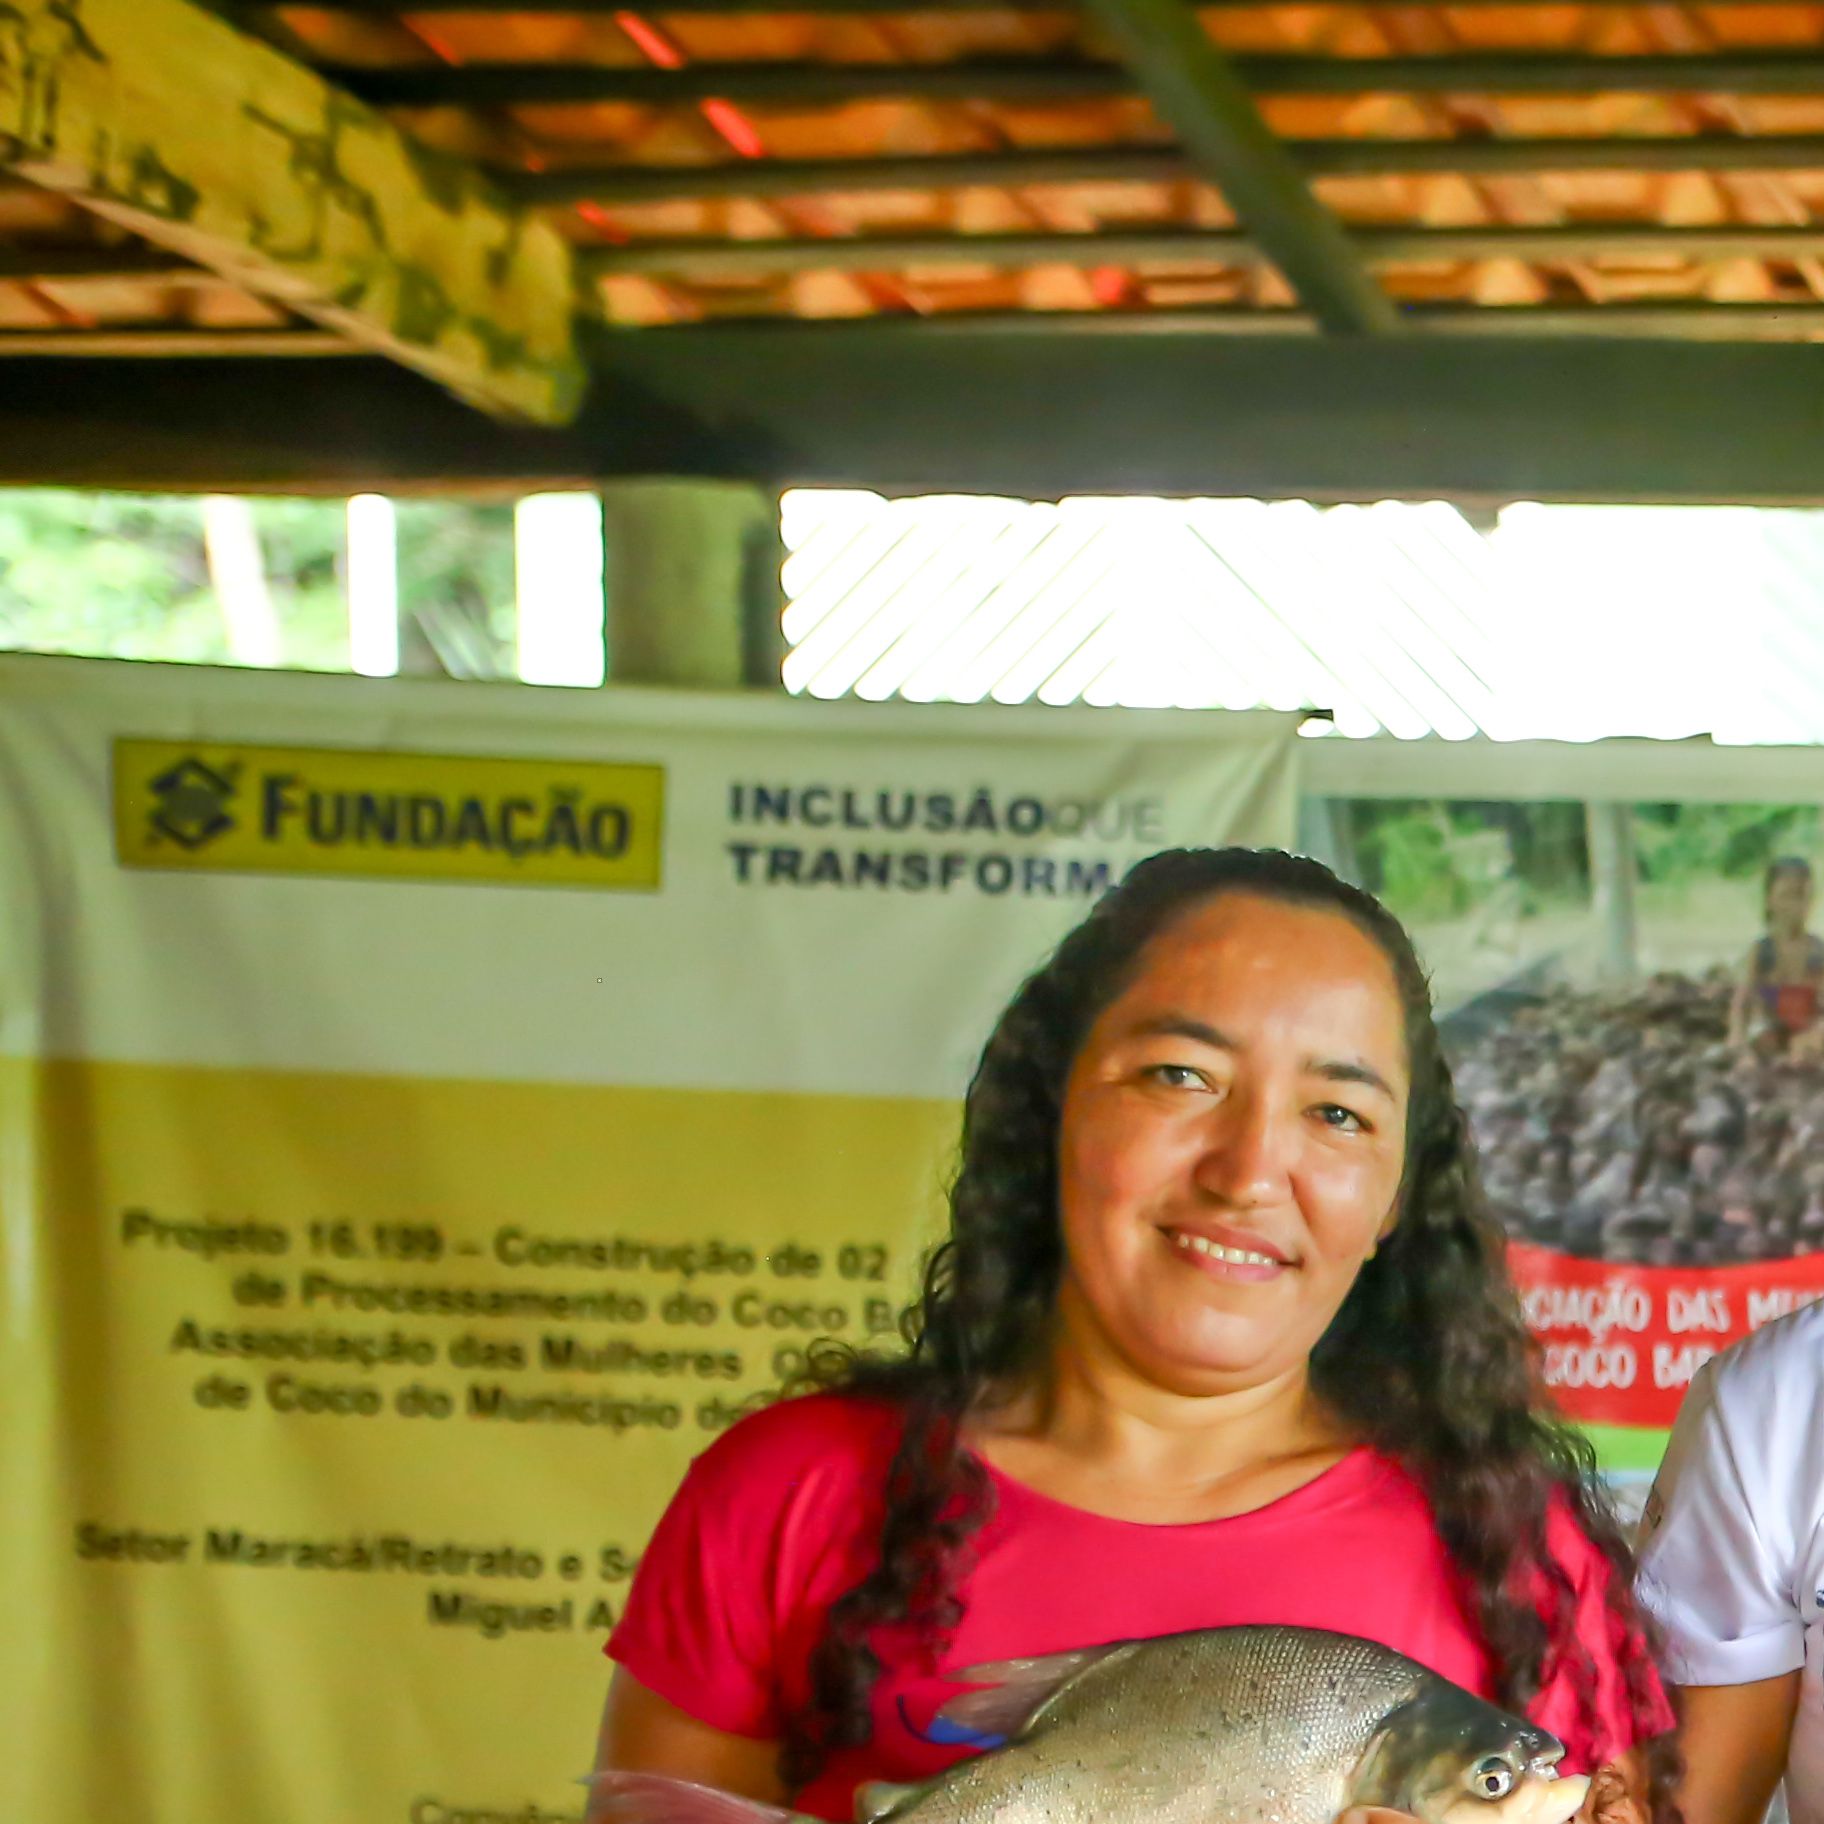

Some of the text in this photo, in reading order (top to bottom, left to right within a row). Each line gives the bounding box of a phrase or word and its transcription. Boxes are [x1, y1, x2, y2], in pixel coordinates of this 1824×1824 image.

[725, 842, 1116, 898] TRANSFORM
[122, 1207, 290, 1262] Projeto
[494, 1227, 755, 1277] Construção
[769, 1241, 821, 1278] de
[837, 1244, 888, 1281] 02
[231, 1271, 288, 1308] de
[302, 1268, 645, 1324] Processamento
[661, 1293, 719, 1327] do
[732, 1292, 848, 1331] Coco
[1667, 1288, 1731, 1333] DAS
[172, 1317, 437, 1370] Associação
[449, 1331, 528, 1370] das
[540, 1334, 743, 1380] Mulheres
[194, 1372, 251, 1410] de
[266, 1373, 382, 1415] Coco
[395, 1378, 454, 1418] do
[75, 1523, 190, 1563] Setor
[557, 1549, 584, 1581] e
[427, 1590, 573, 1640] Miguel
